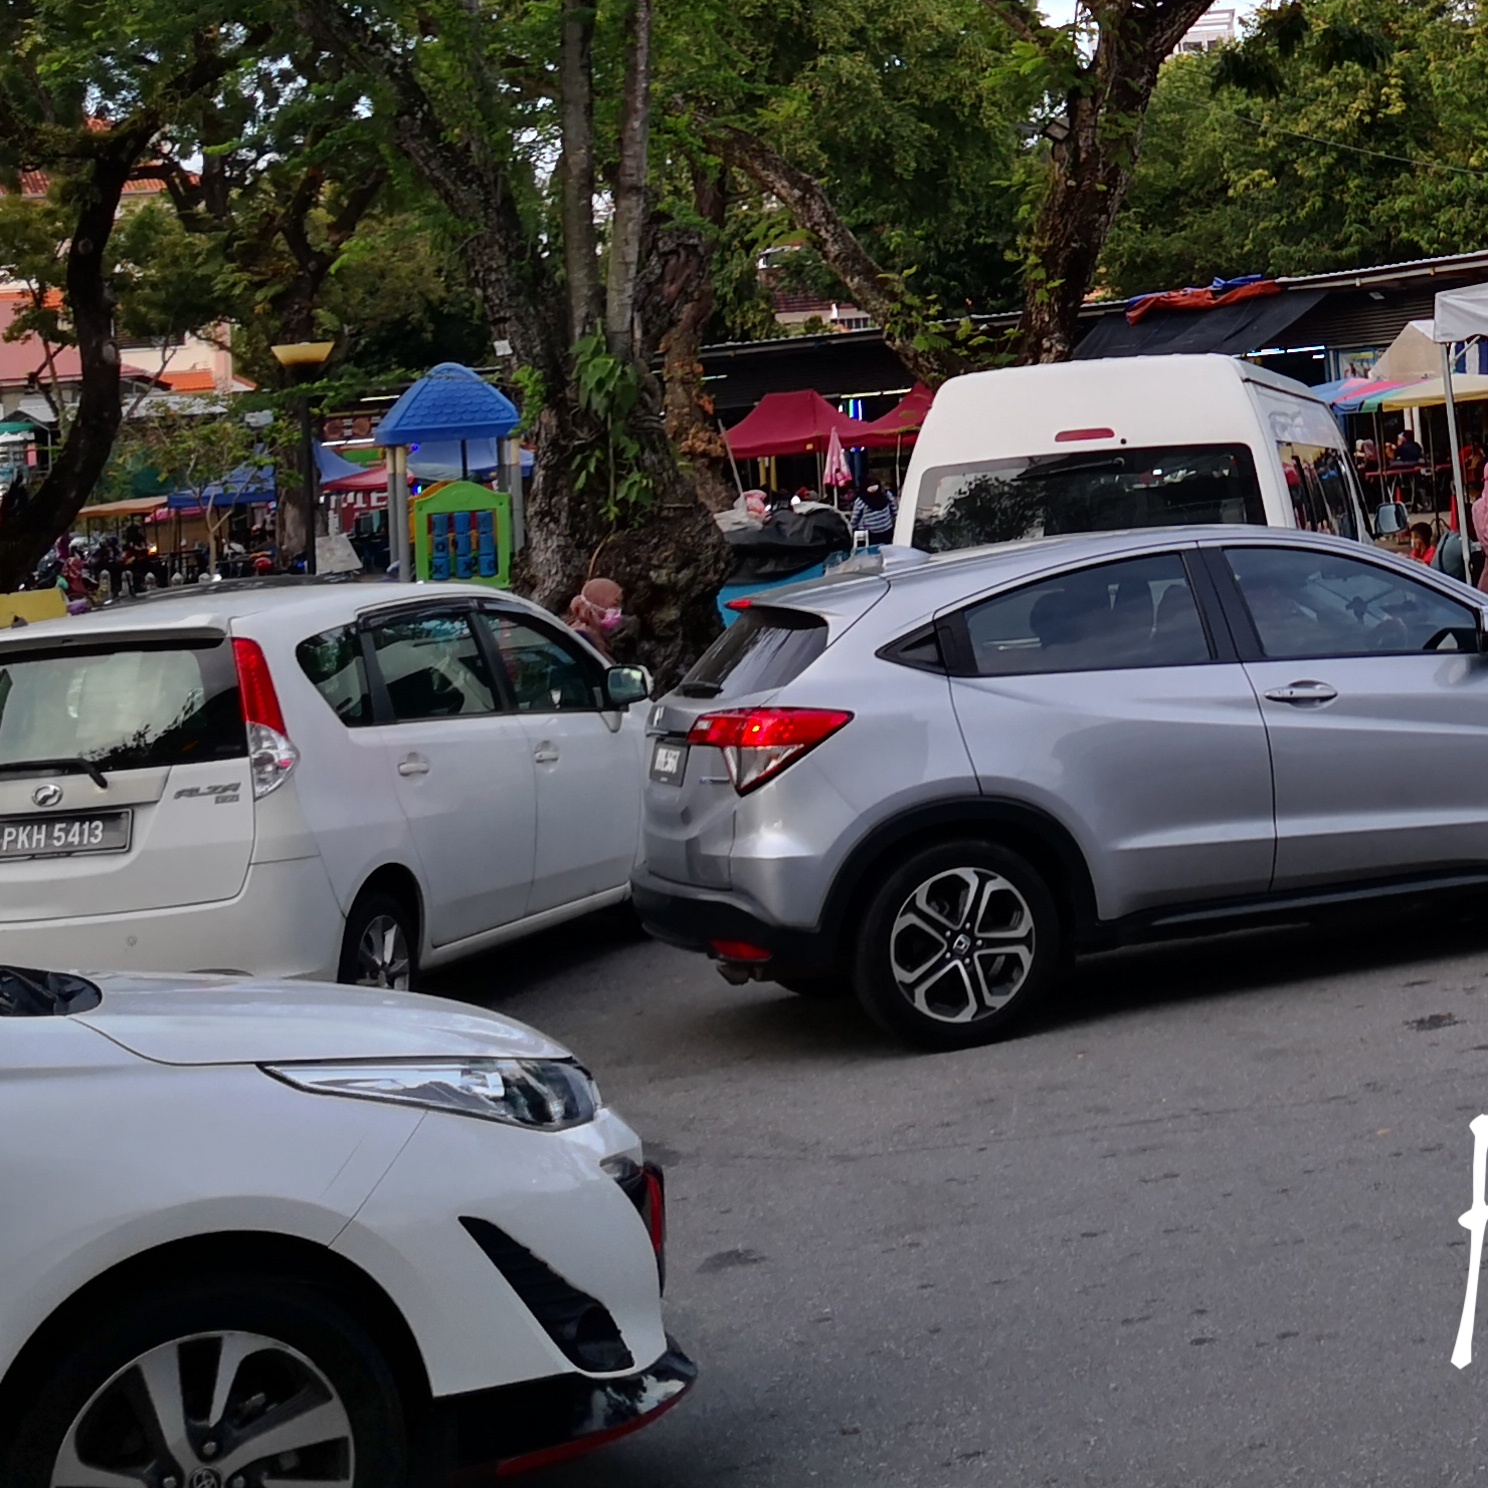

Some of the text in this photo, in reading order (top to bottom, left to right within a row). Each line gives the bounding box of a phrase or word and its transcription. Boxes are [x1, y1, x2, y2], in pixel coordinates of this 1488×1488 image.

[174, 782, 241, 799] ALZA
[2, 820, 104, 851] PKH 5413
